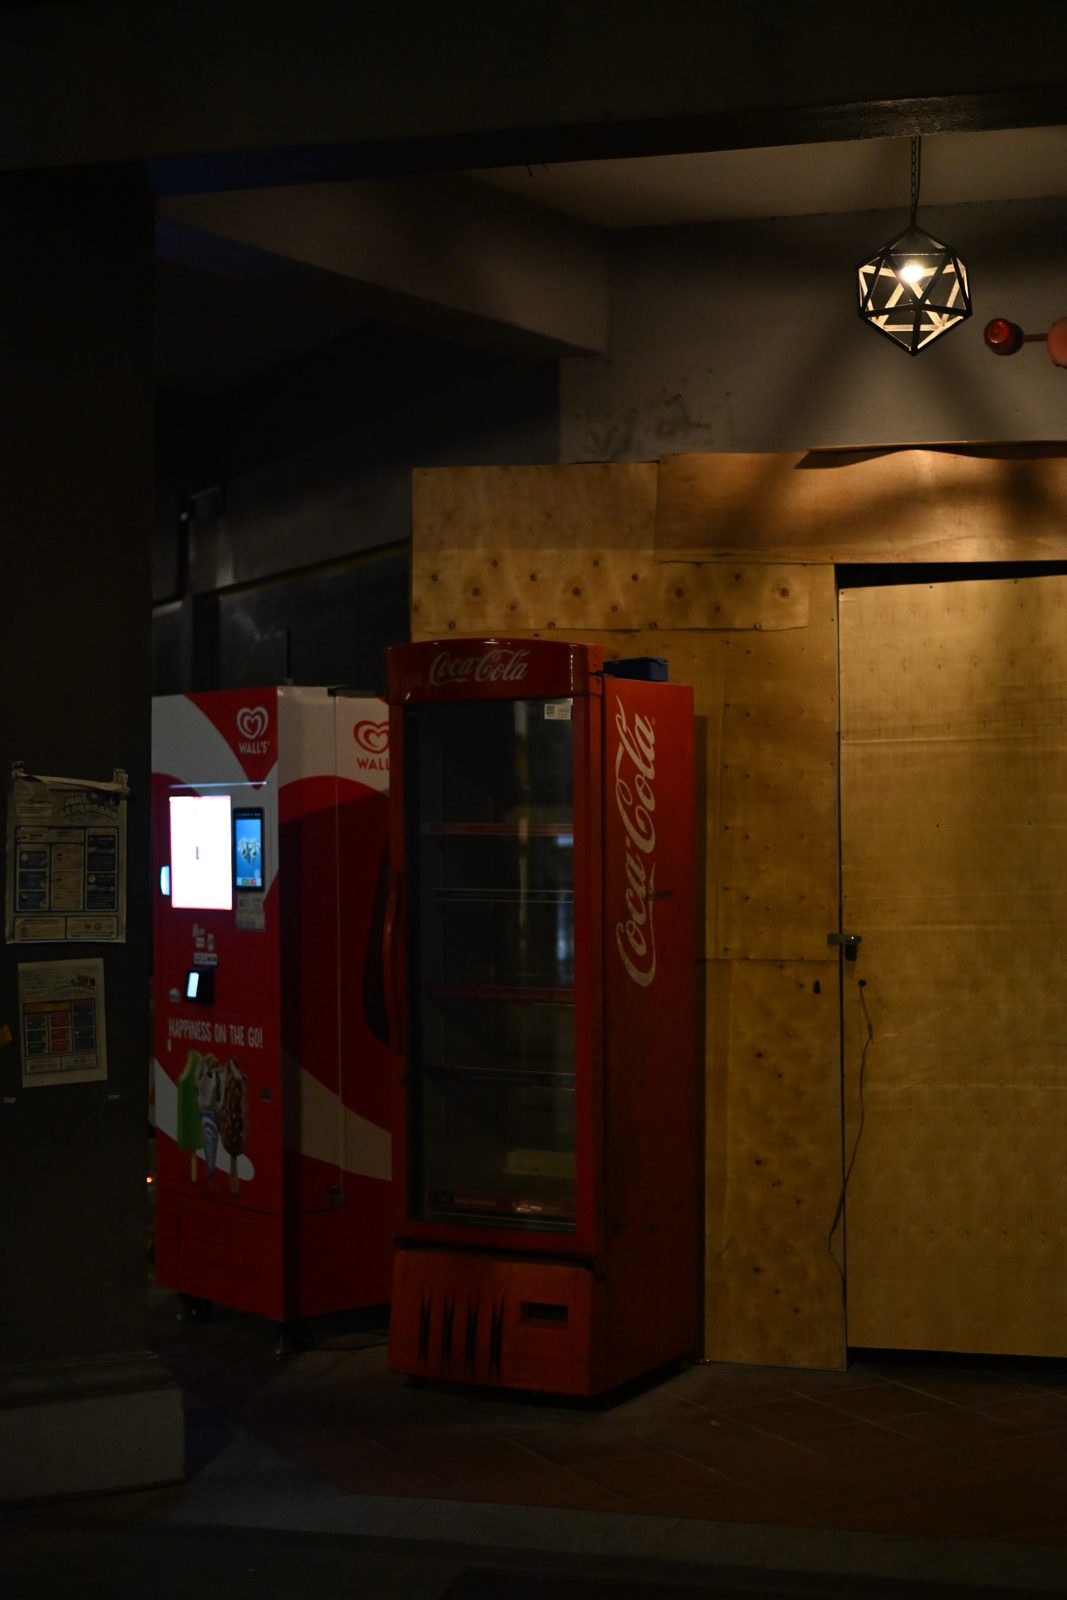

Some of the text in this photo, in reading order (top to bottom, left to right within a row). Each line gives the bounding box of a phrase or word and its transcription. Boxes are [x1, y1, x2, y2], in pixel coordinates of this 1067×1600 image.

[238, 740, 269, 754] WALL'S
[168, 1017, 264, 1049] HAPPINESS ON THE GO!
